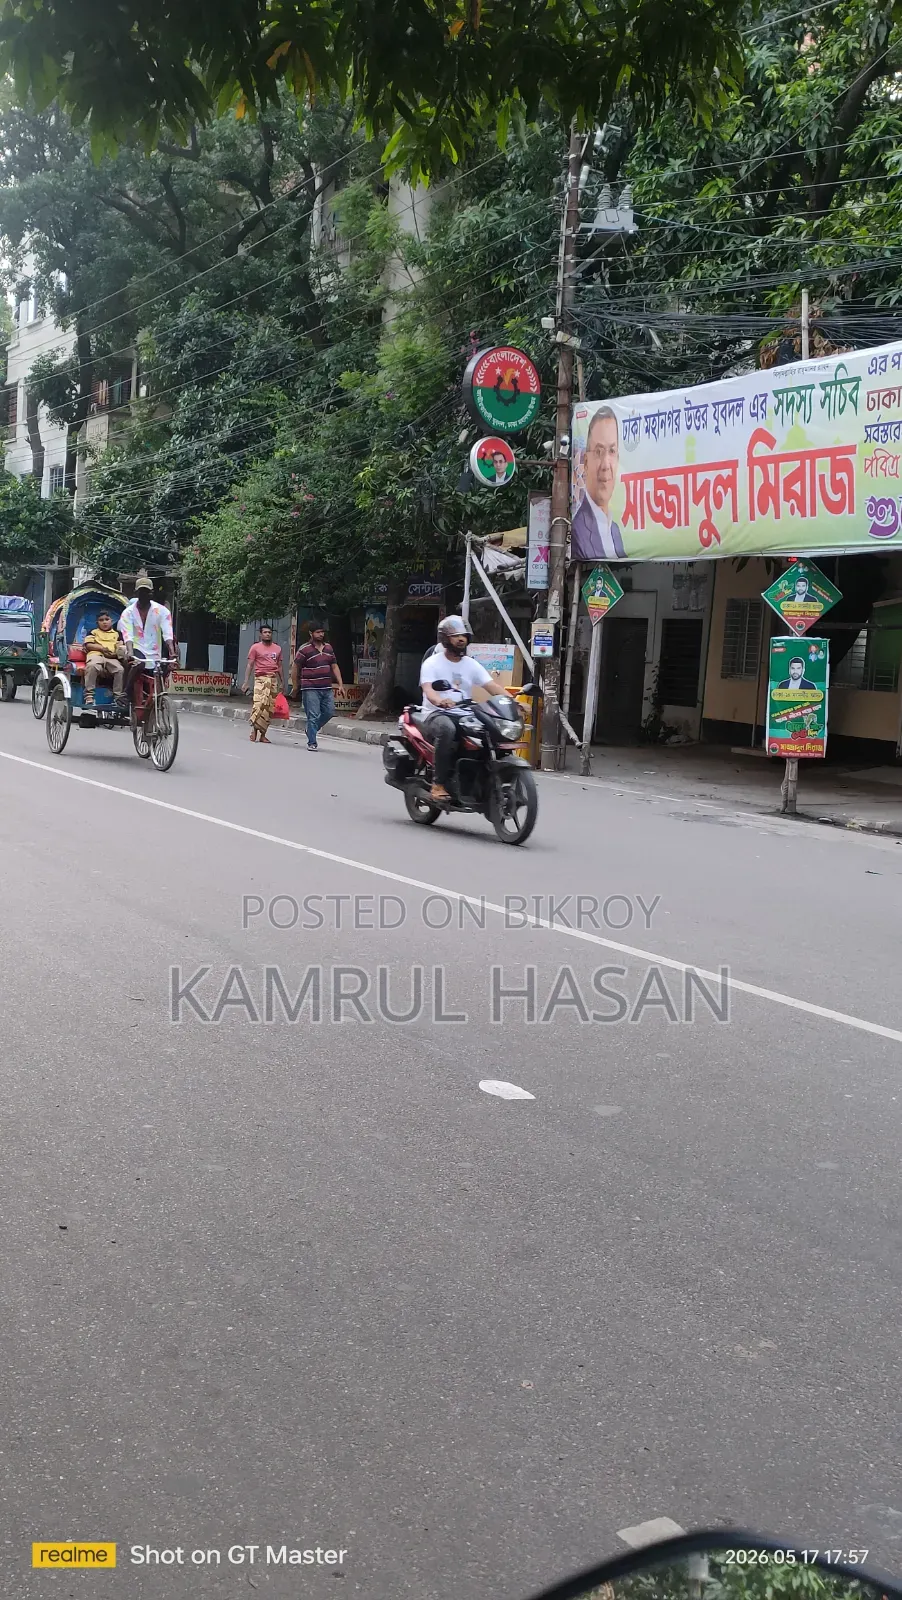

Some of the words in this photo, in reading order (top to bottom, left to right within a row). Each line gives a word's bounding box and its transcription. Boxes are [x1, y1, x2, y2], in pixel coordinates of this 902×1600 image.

[488, 350, 527, 368] বাংলাদেশ
[867, 354, 889, 376] এর
[622, 415, 641, 442] ঢাকা
[644, 406, 681, 441] মহানগর
[684, 396, 709, 429] উত্তর
[712, 397, 745, 435] যুবদল
[749, 393, 768, 421] এর
[772, 383, 815, 426] সদস্য
[819, 362, 862, 420] সচিব
[864, 447, 901, 478] পবিত্র
[620, 459, 739, 548] সাজ্জাদুল
[746, 426, 858, 523] মিরাজ
